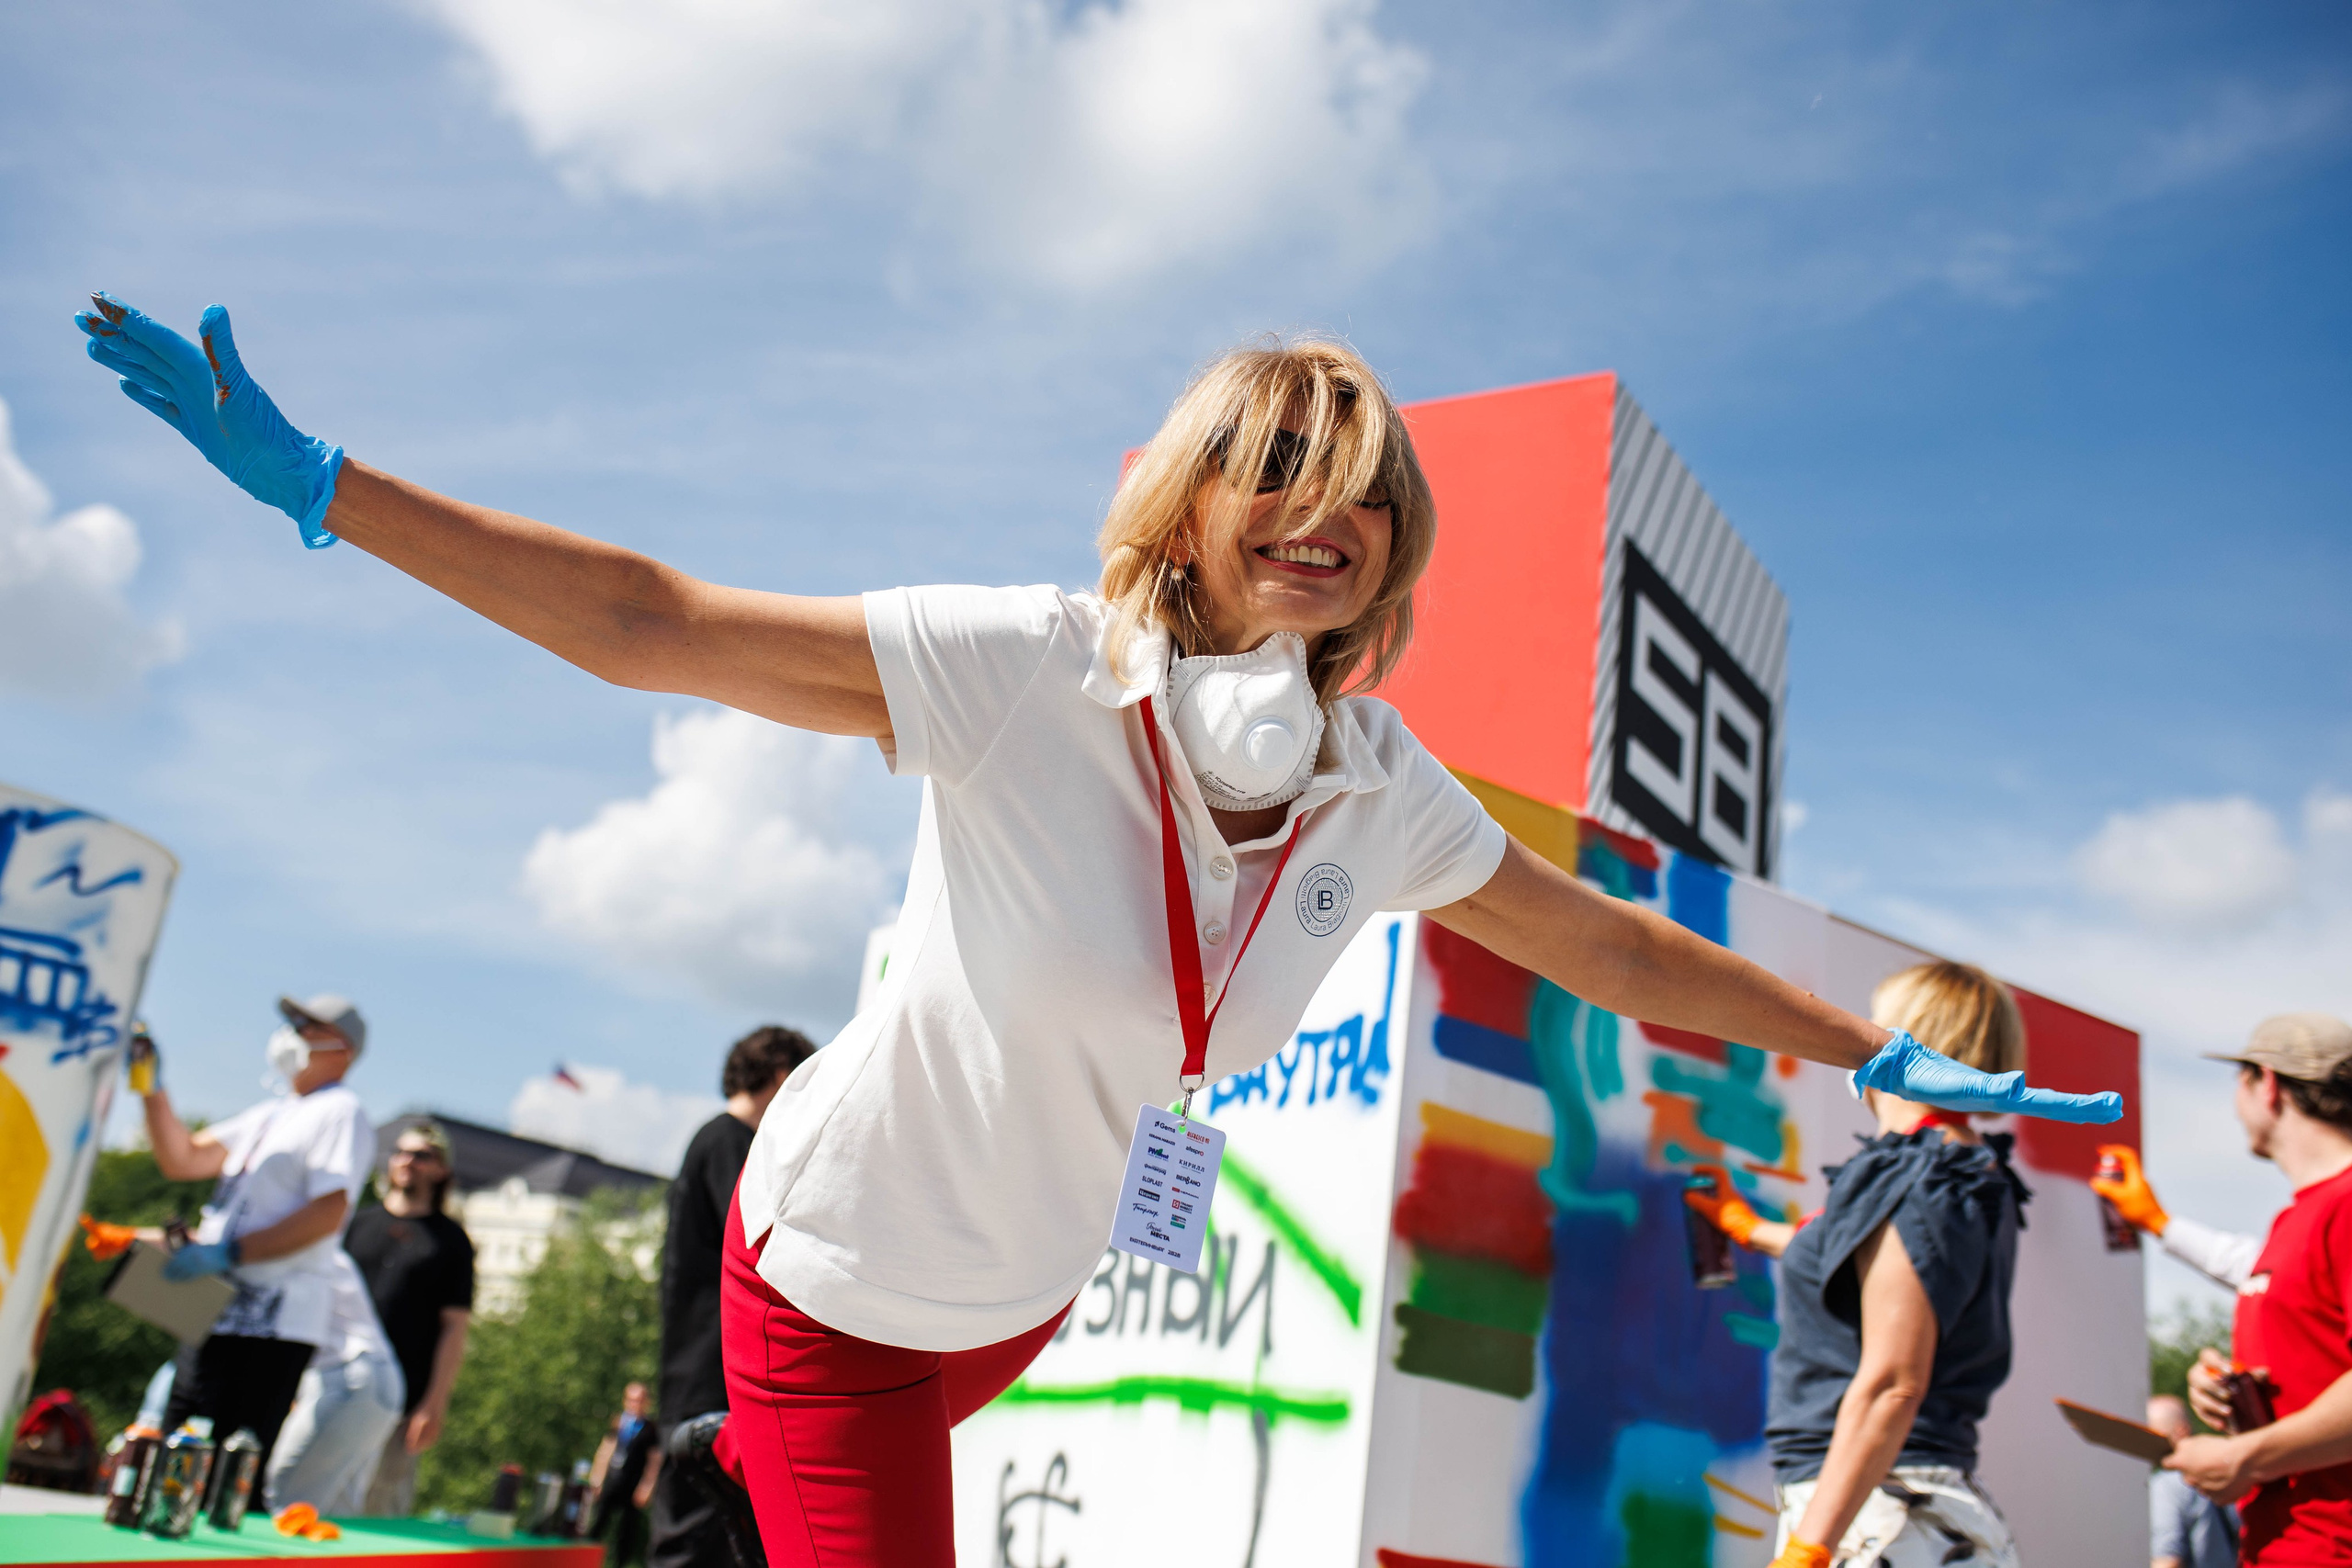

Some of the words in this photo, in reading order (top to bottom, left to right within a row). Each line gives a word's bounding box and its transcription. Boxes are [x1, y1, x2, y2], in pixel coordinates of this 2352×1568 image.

[1300, 900, 1312, 925] Laura
[1159, 1122, 1176, 1134] Gems
[1179, 1158, 1205, 1173] КИРИЛЛ
[1150, 1231, 1170, 1242] МЕСТА
